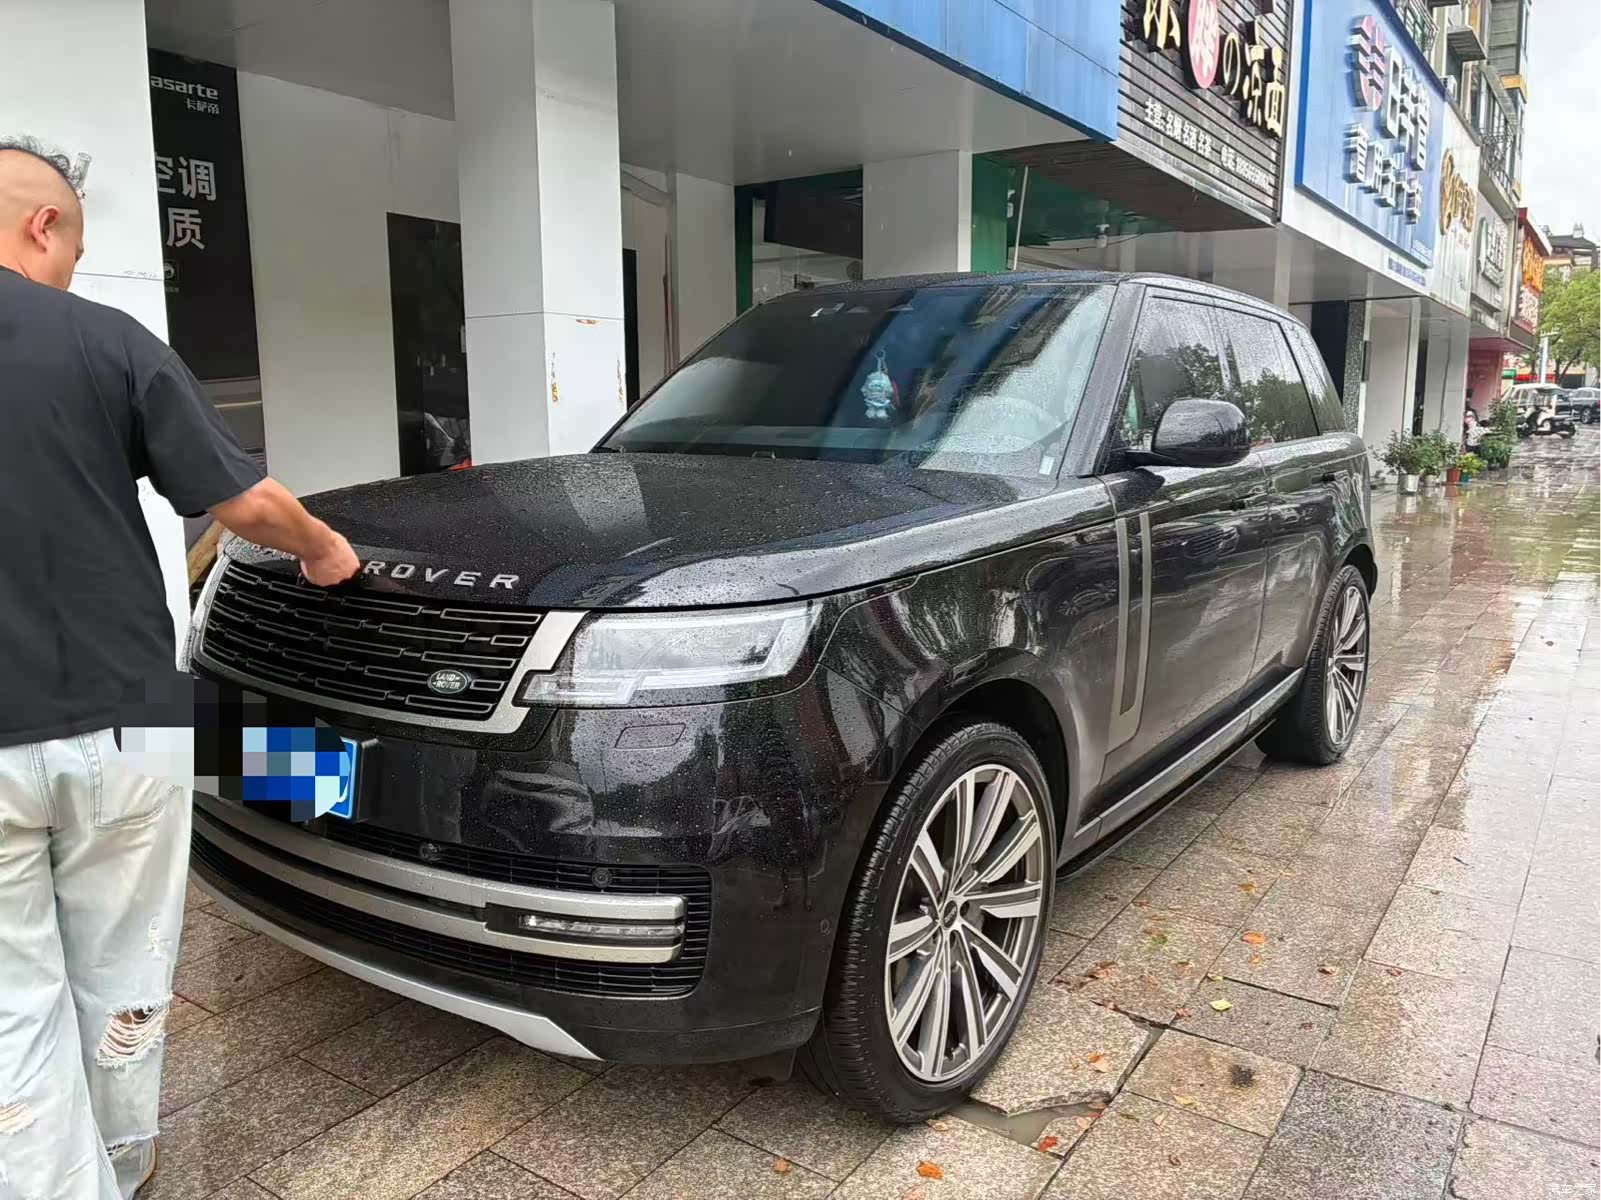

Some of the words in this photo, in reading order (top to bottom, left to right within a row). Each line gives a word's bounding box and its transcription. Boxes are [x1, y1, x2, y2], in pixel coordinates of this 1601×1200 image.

[184, 98, 220, 115] 卡萨帝
[166, 206, 206, 250] 质
[363, 560, 520, 590] ROVER
[435, 672, 457, 682] LAND
[435, 680, 461, 690] ROVER
